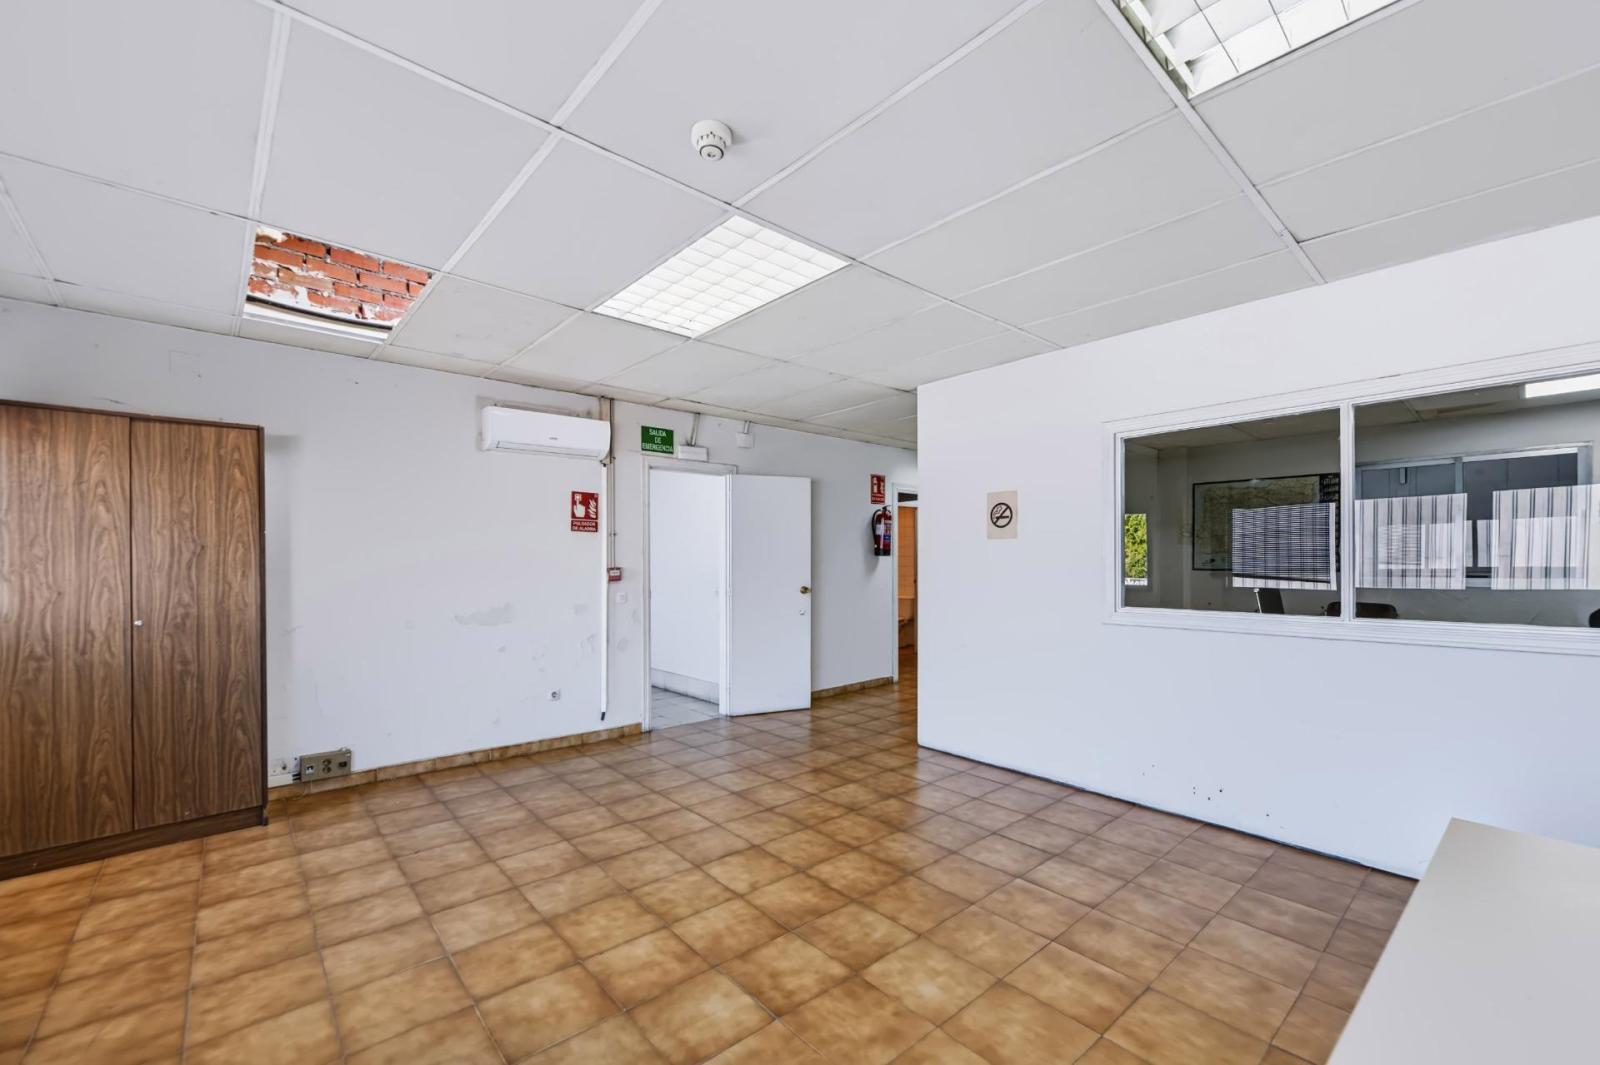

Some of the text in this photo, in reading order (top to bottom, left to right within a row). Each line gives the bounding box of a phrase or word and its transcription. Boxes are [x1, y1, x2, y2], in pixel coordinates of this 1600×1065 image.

[649, 428, 667, 437] SALIDA
[654, 436, 662, 444] DE
[642, 442, 673, 452] EMERGENCIA
